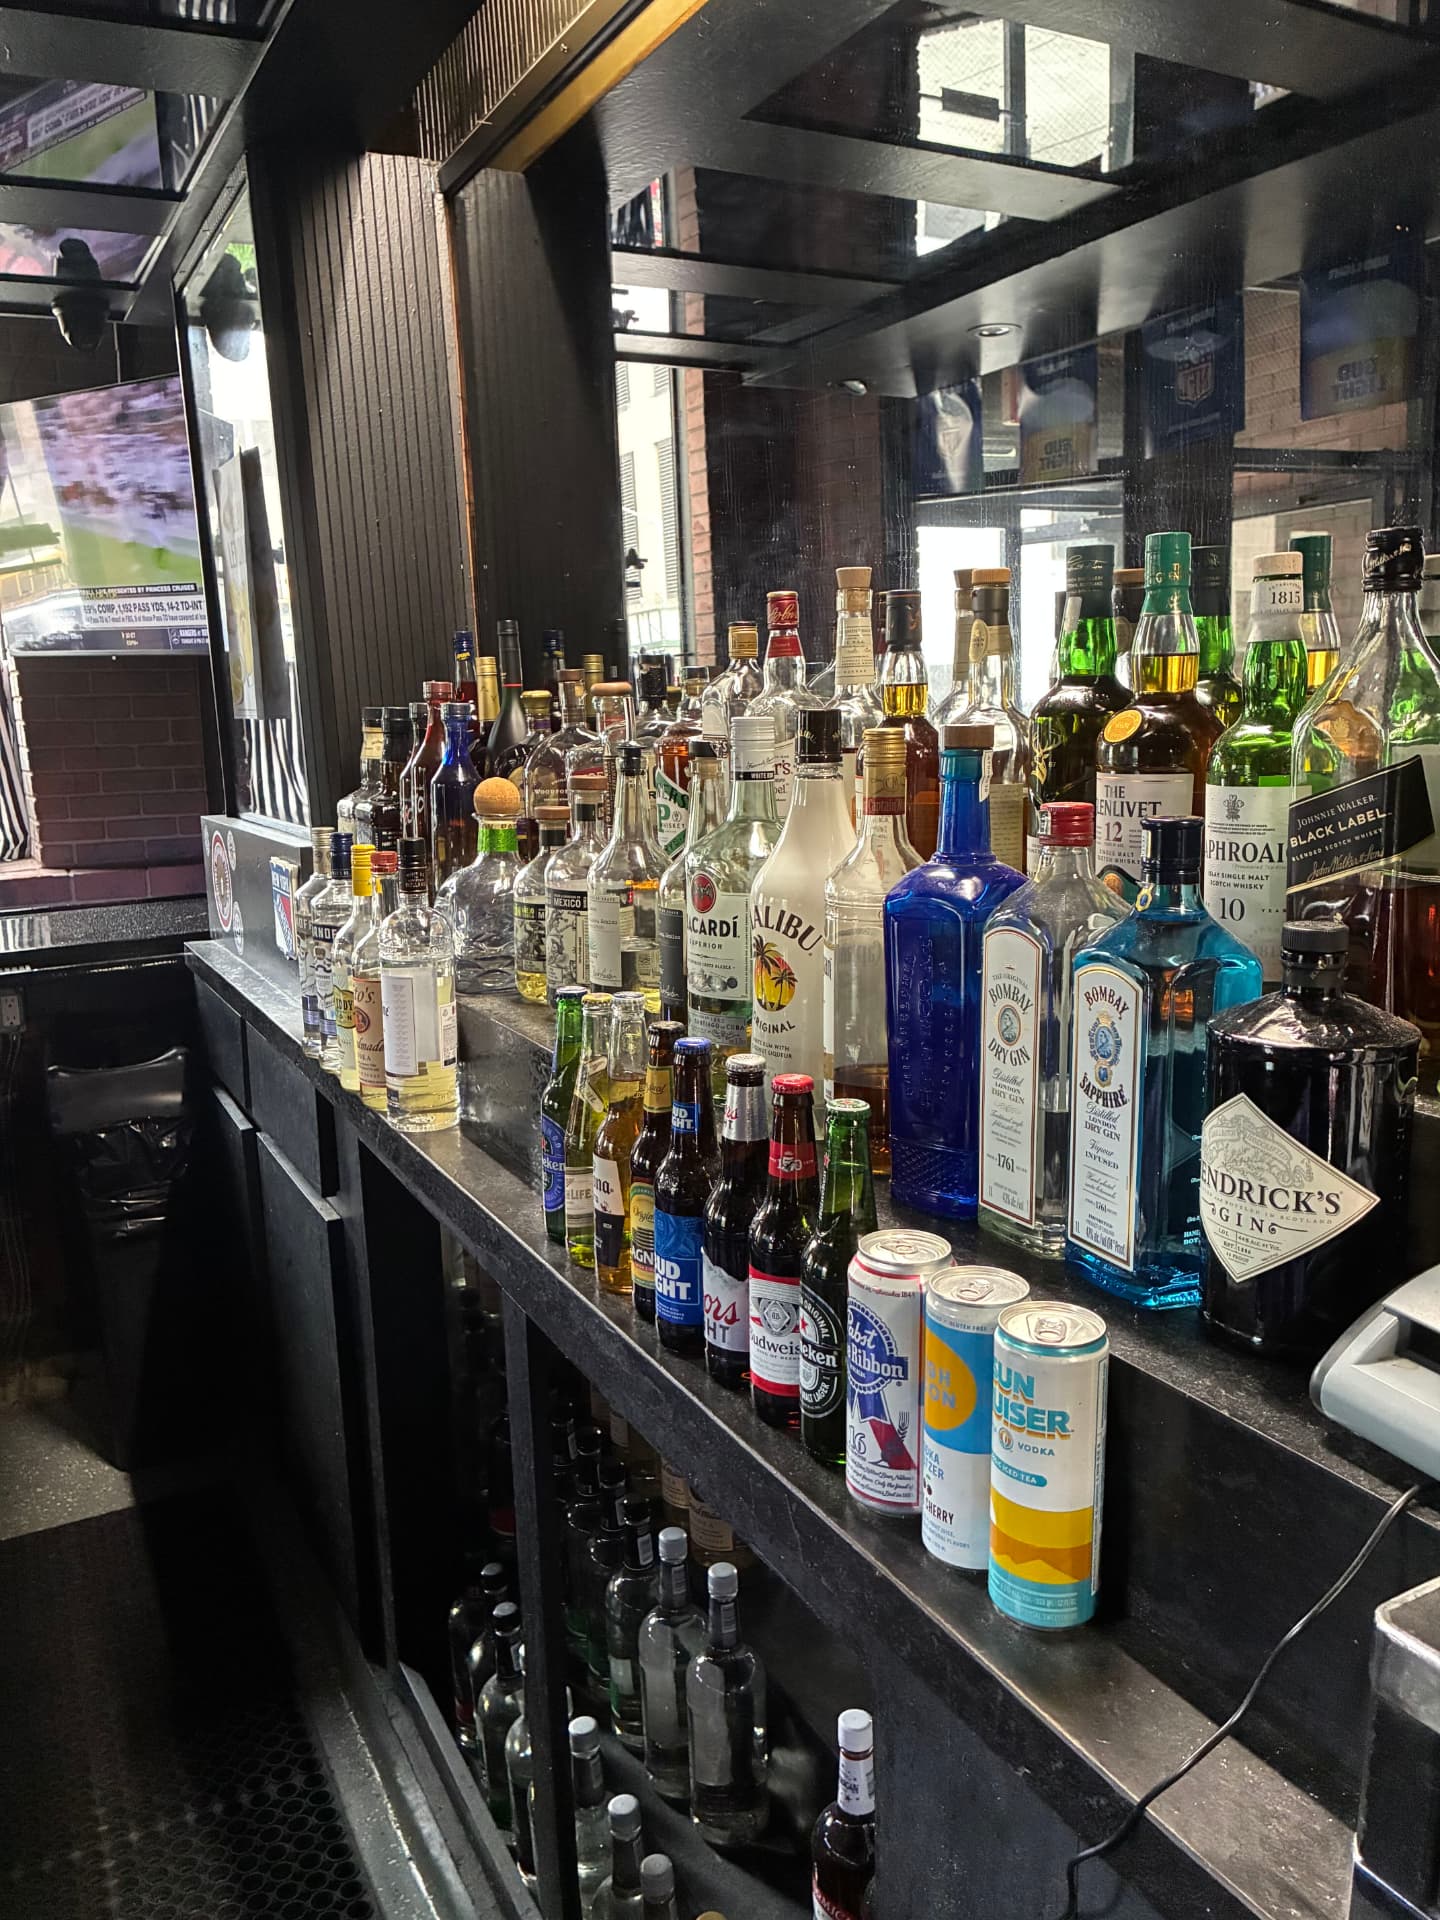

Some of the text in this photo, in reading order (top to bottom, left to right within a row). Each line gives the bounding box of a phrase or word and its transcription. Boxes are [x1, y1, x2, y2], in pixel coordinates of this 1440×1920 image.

[145, 584, 171, 593] PRINCESS
[1271, 591, 1300, 605] 1815
[97, 603, 119, 615] COMP,
[133, 602, 151, 612] PASS
[151, 601, 167, 612] YDS,
[167, 601, 180, 611] 14-2
[181, 600, 203, 610] TD-INT
[1104, 785, 1126, 799] THE
[1097, 799, 1162, 818] ENLIVET
[1297, 808, 1336, 831] JOHNNIE
[1337, 794, 1375, 814] WALKER
[1104, 821, 1123, 843] 12
[1290, 824, 1336, 848] BLACK
[1338, 808, 1388, 832] LABEL
[1206, 840, 1288, 864] PHROAI
[1292, 827, 1384, 862] BLENDED SCOTCH WHISKY
[1210, 880, 1264, 891] SCOTCH WHISKY
[1221, 872, 1246, 881] SINGLE
[554, 897, 581, 909] MEXICO
[1220, 896, 1246, 922] 10
[751, 904, 823, 952] ALIBU
[354, 986, 376, 1005] to's
[988, 983, 1034, 1014] BOMBAY
[1084, 985, 1130, 1019] BOMBAY
[988, 1038, 1031, 1067] DRY GIN
[991, 1088, 1025, 1105] DRY GIN
[994, 1082, 1021, 1095] LONDON
[1080, 1075, 1129, 1109] SAPPHIRE
[672, 1106, 688, 1119] UD
[1086, 1101, 1120, 1123] Distilled
[1084, 1121, 1121, 1142] DRY GIN
[1088, 1115, 1117, 1130] LONDON
[543, 1158, 565, 1172] eken
[997, 1153, 1015, 1173] 1761
[1085, 1151, 1119, 1170] INFUSED
[571, 1188, 592, 1200] LIFE
[1202, 1162, 1341, 1215] ENDRICK'S
[1219, 1206, 1265, 1233] GIN
[1279, 1215, 1333, 1225] SCOTLAND
[704, 1293, 740, 1326] ors
[804, 1300, 830, 1338] ORIGINAL
[949, 1321, 972, 1330] GLUTEN
[851, 1343, 904, 1379] Ribbon
[993, 1357, 1035, 1404] SUN
[928, 1383, 956, 1409] ON
[848, 1424, 867, 1455] 16
[1017, 1441, 1056, 1457] VODKA
[1020, 1474, 1038, 1485] TEA
